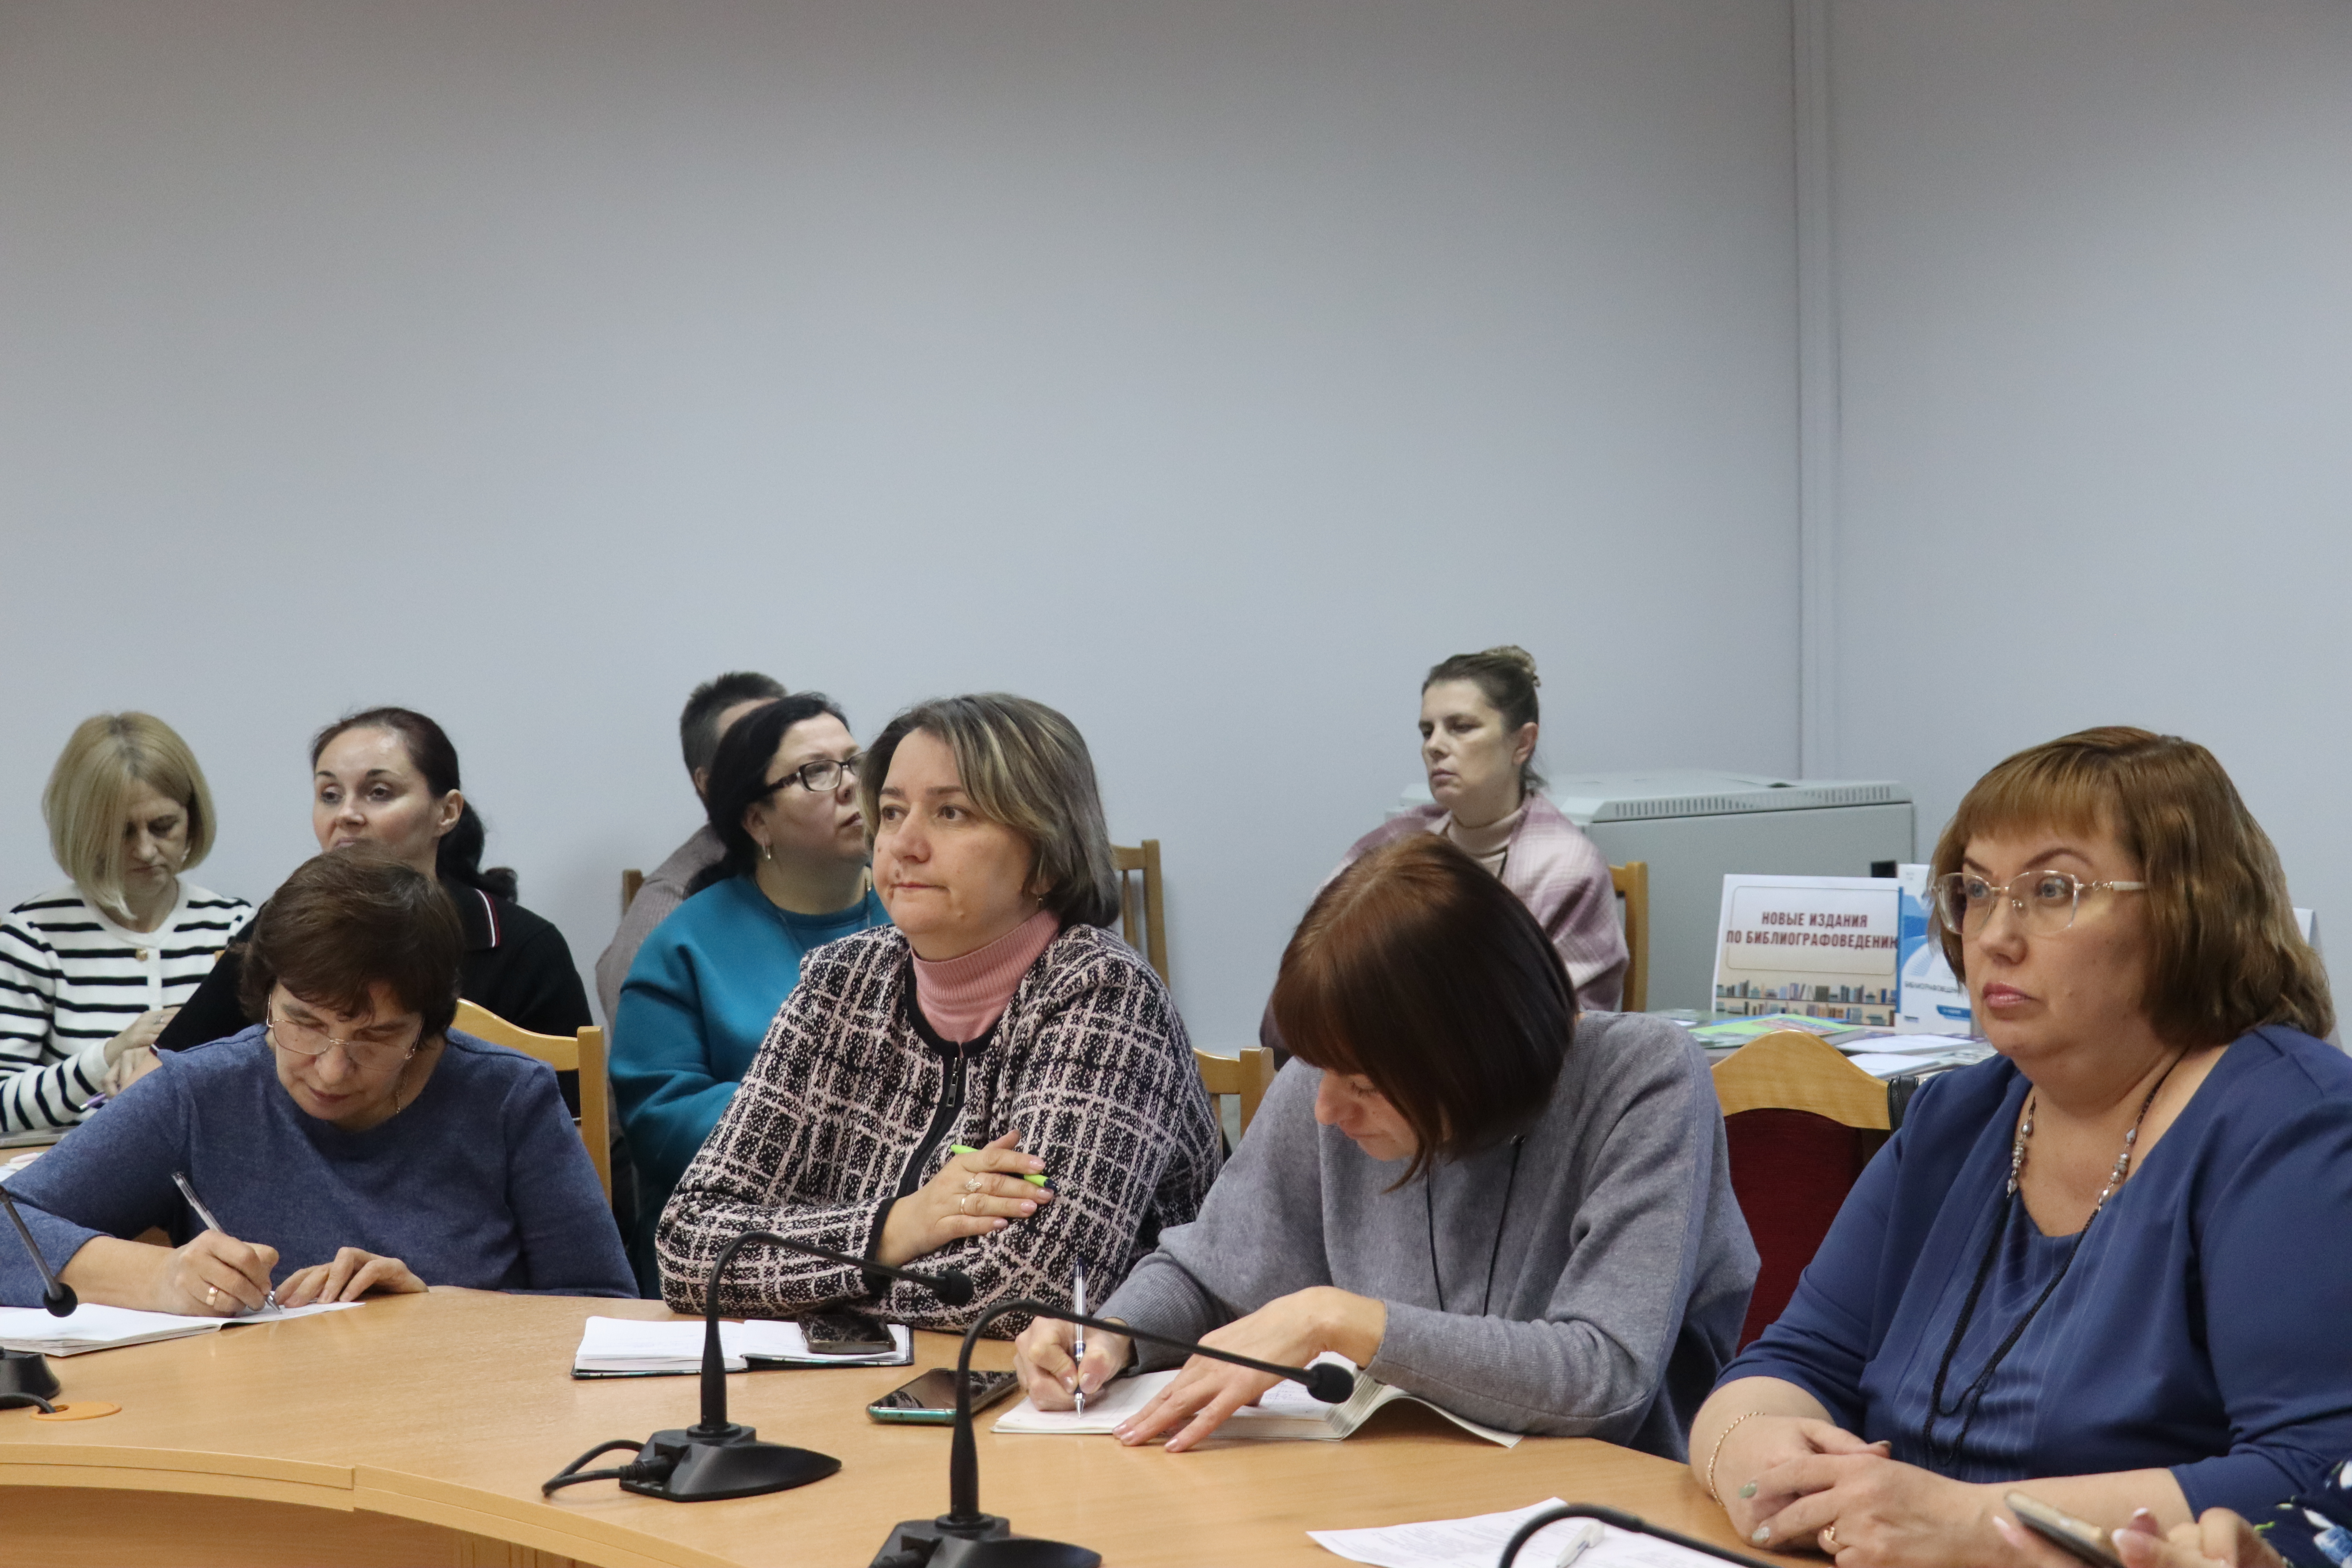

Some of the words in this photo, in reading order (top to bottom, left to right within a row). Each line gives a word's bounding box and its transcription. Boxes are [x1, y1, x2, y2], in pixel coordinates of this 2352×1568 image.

[1762, 911, 1805, 926] НОВЫЕ
[1809, 913, 1867, 929] ИЗДАНИЯ
[1726, 930, 1742, 944] ПО
